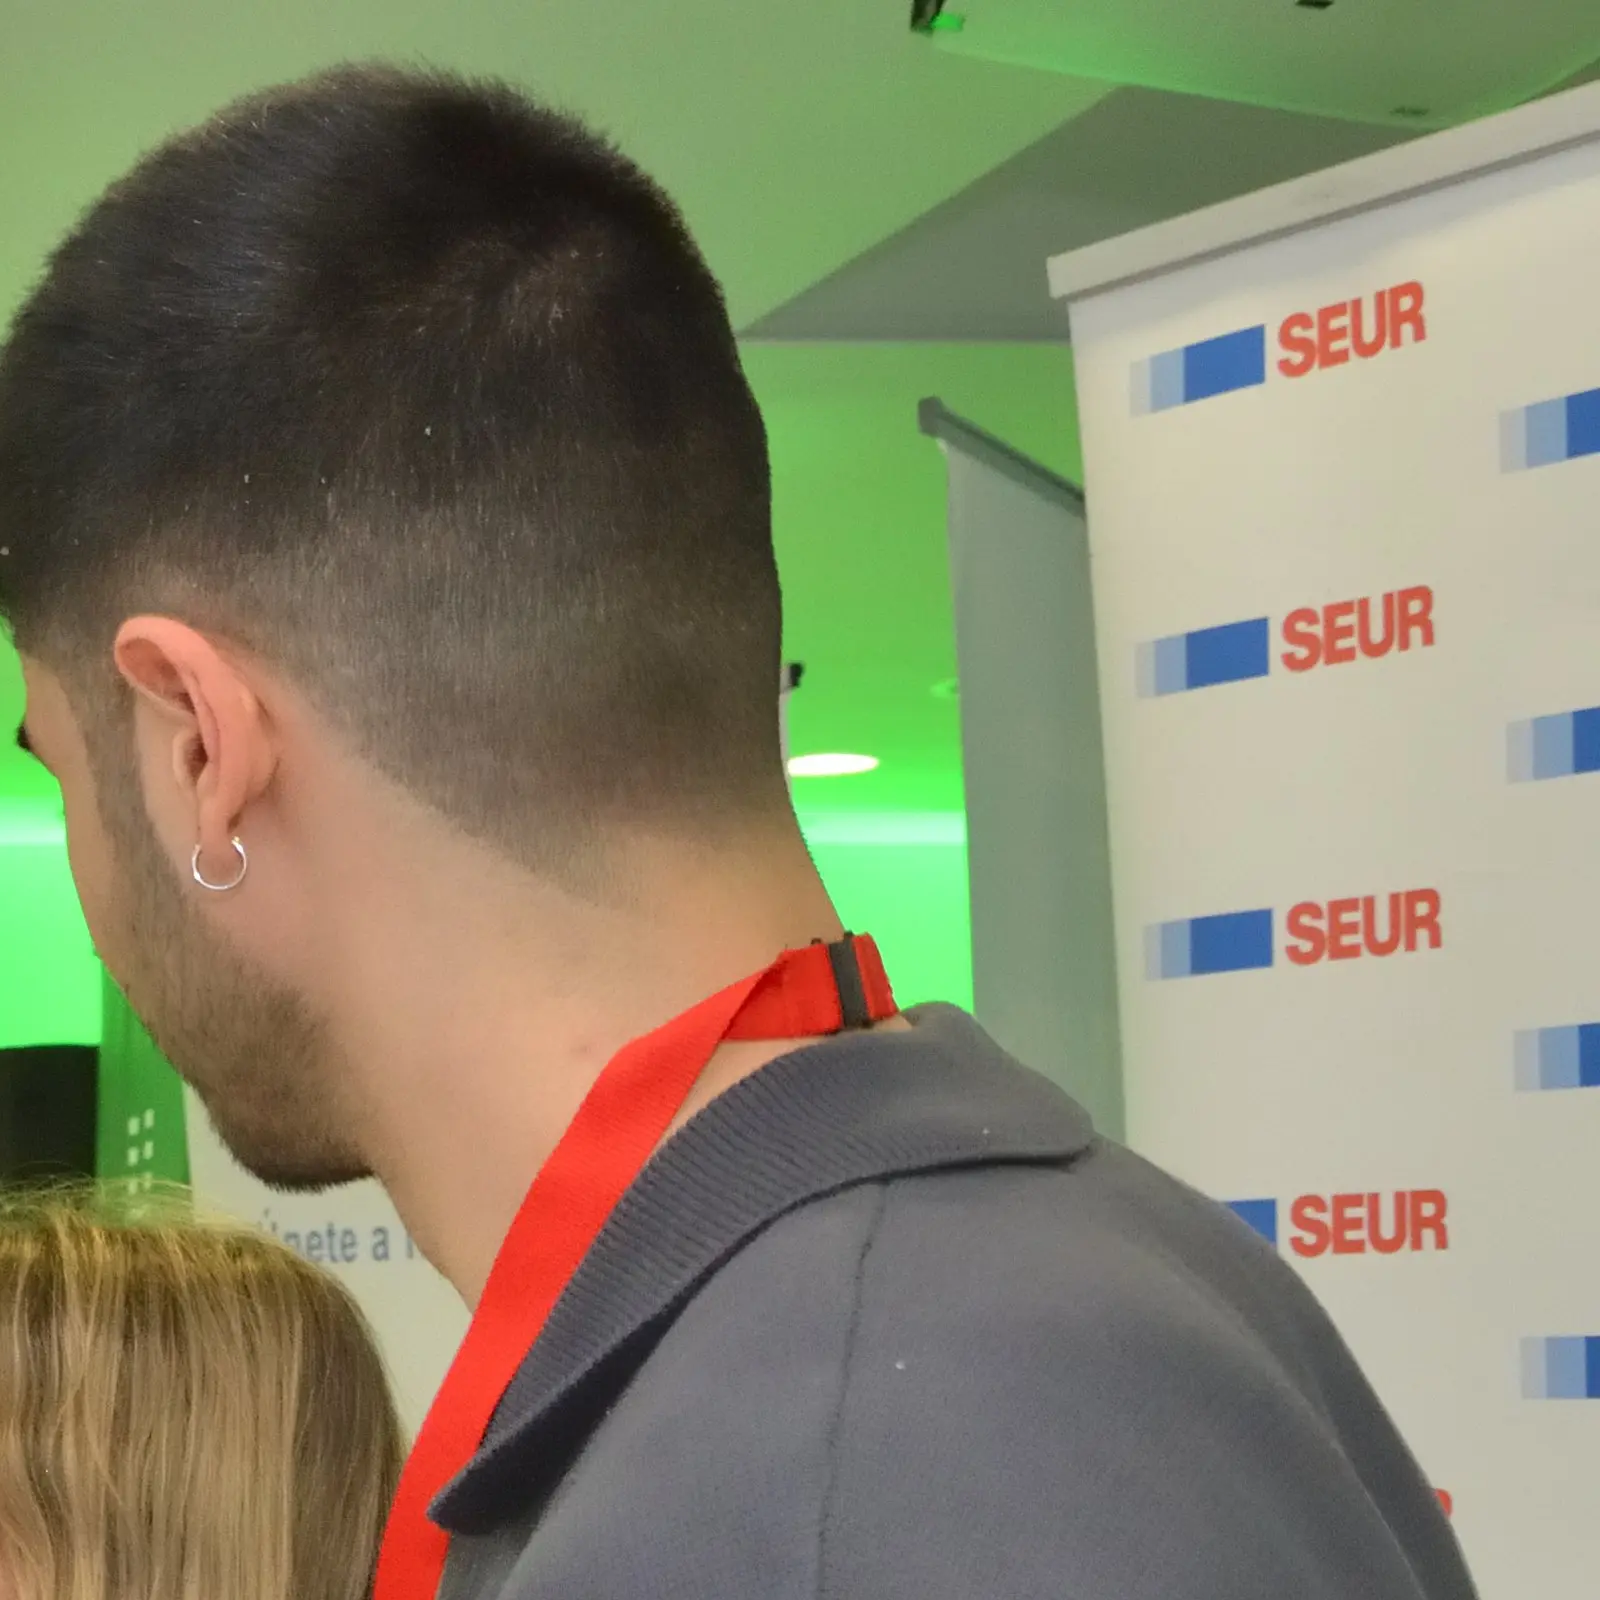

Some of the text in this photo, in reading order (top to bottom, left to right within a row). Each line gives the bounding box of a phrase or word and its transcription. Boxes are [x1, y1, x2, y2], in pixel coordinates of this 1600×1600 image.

[1277, 281, 1427, 378] SEUR
[1281, 585, 1436, 673] SEUR
[1285, 887, 1442, 966] SEUR
[263, 1207, 358, 1263] nete
[371, 1224, 390, 1262] a
[1290, 1188, 1448, 1258] SEUR
